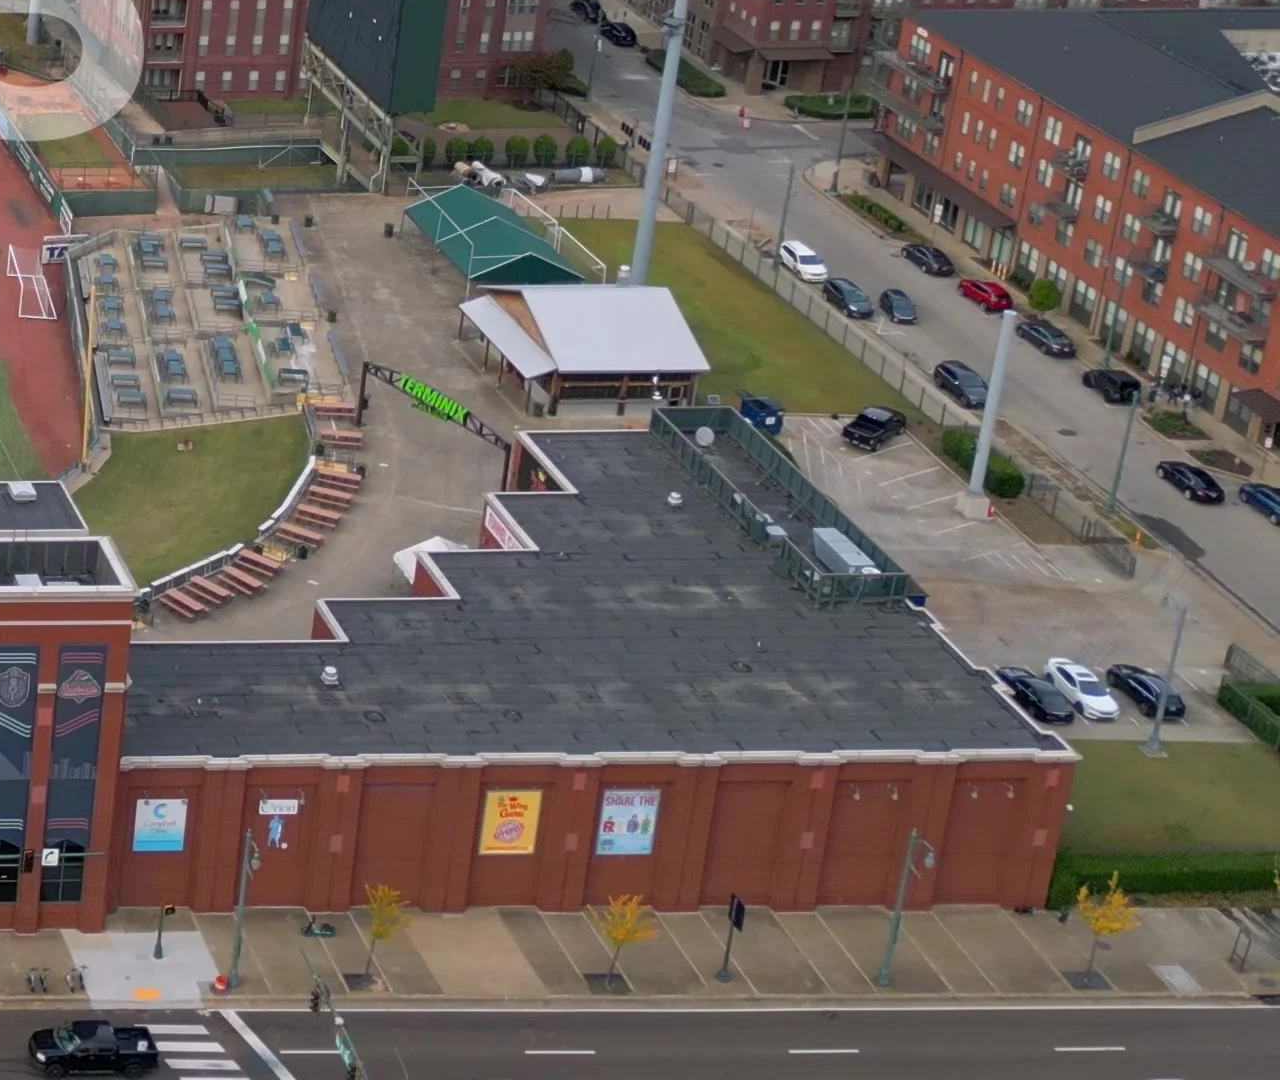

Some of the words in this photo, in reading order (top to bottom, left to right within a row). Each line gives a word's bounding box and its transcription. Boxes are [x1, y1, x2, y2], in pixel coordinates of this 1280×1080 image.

[400, 373, 469, 425] TERMINIX
[605, 796, 636, 807] SHARE
[639, 796, 657, 807] THE
